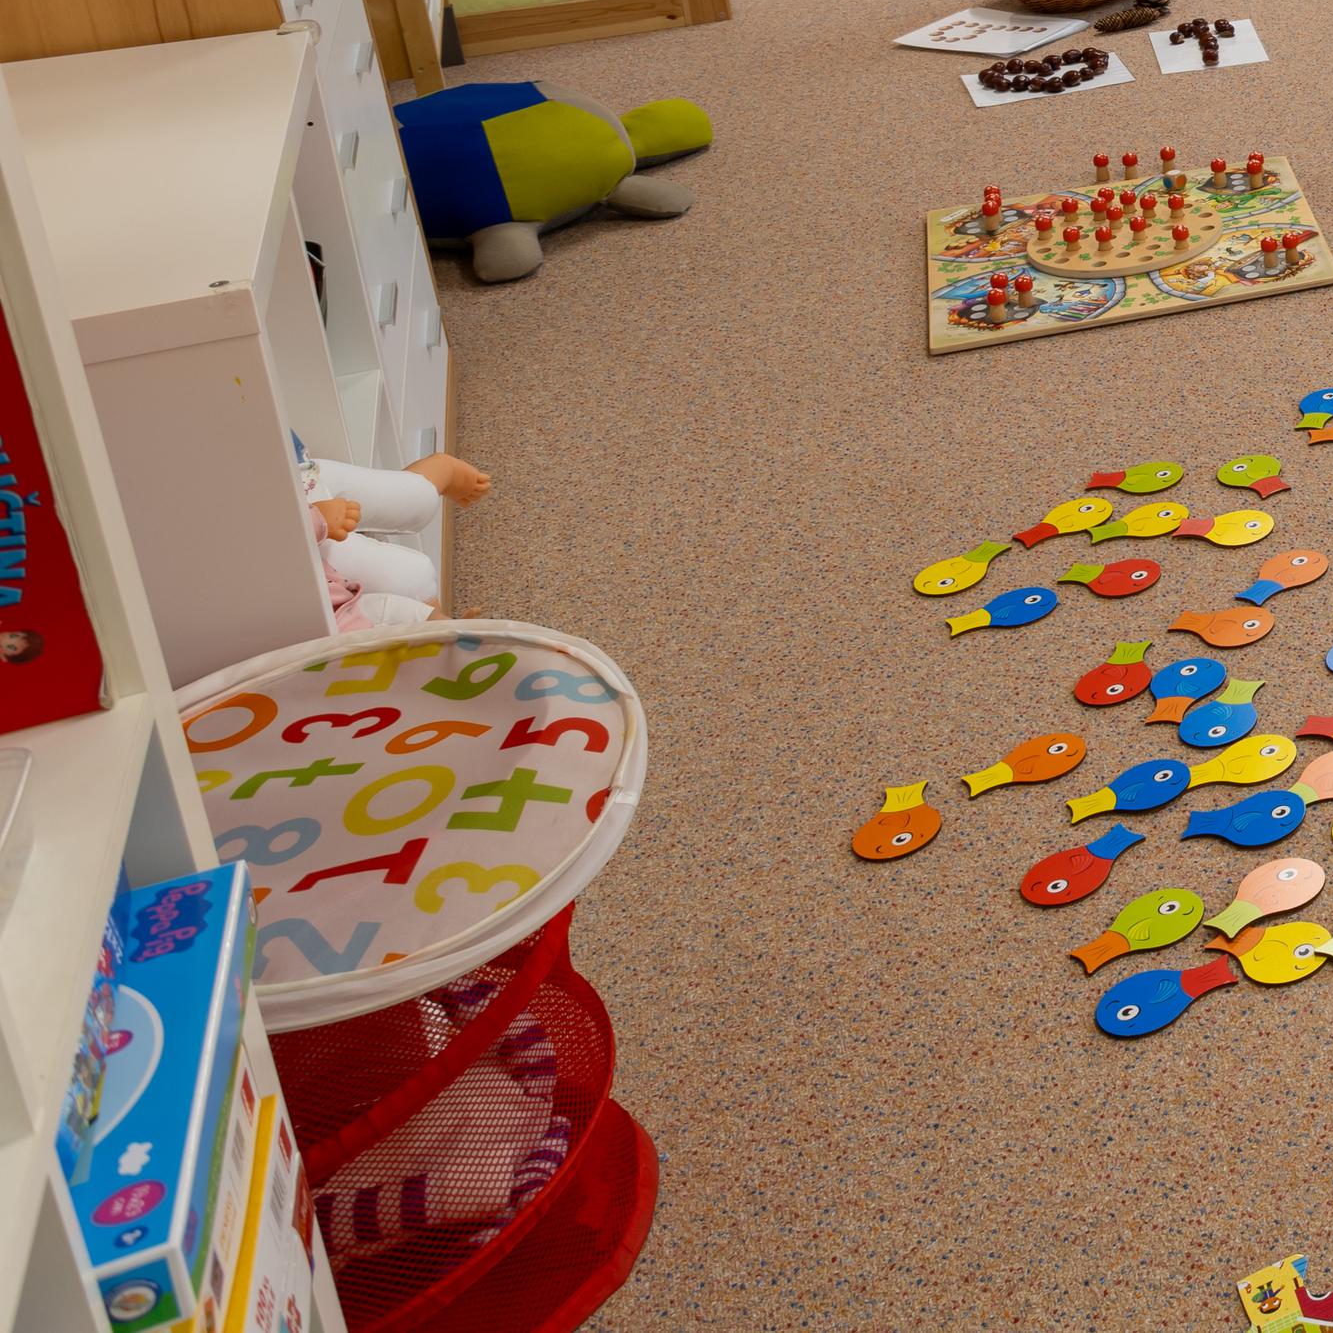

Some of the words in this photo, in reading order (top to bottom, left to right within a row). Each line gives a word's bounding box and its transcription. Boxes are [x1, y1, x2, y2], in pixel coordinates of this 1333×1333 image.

[514, 669, 619, 704] 8
[281, 707, 402, 744] 3
[499, 716, 610, 754] 5
[446, 768, 574, 832] 4
[214, 817, 322, 866] 8
[287, 838, 430, 893] 1
[145, 882, 208, 936] Peppa
[414, 861, 546, 914] 3
[135, 925, 198, 963] Pig
